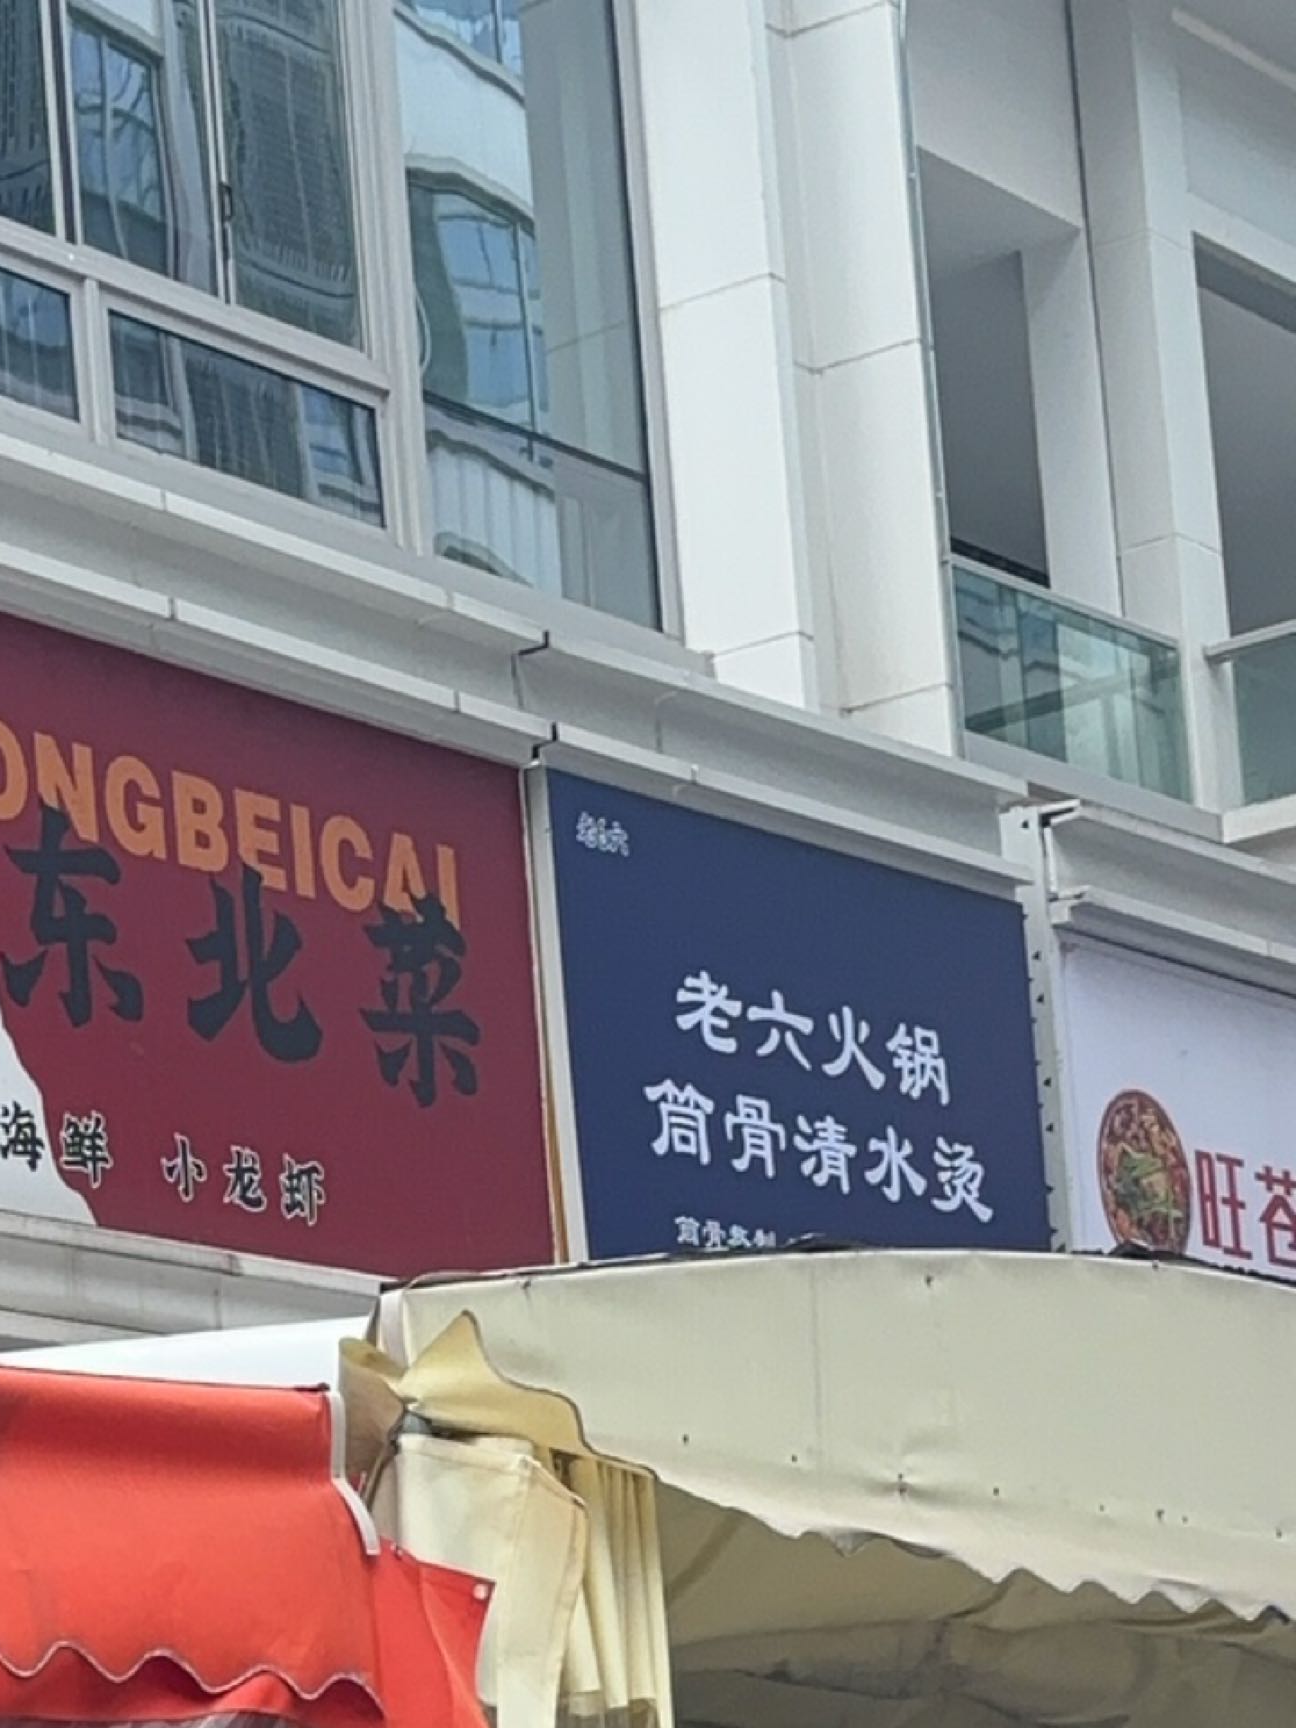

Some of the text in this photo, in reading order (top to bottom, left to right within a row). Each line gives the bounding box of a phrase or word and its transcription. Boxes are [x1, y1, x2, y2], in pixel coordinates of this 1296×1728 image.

[676, 971, 950, 1105] 老六火锅
[165, 1136, 324, 1225] 小龙虾
[645, 1080, 993, 1222] 筒骨清水烫
